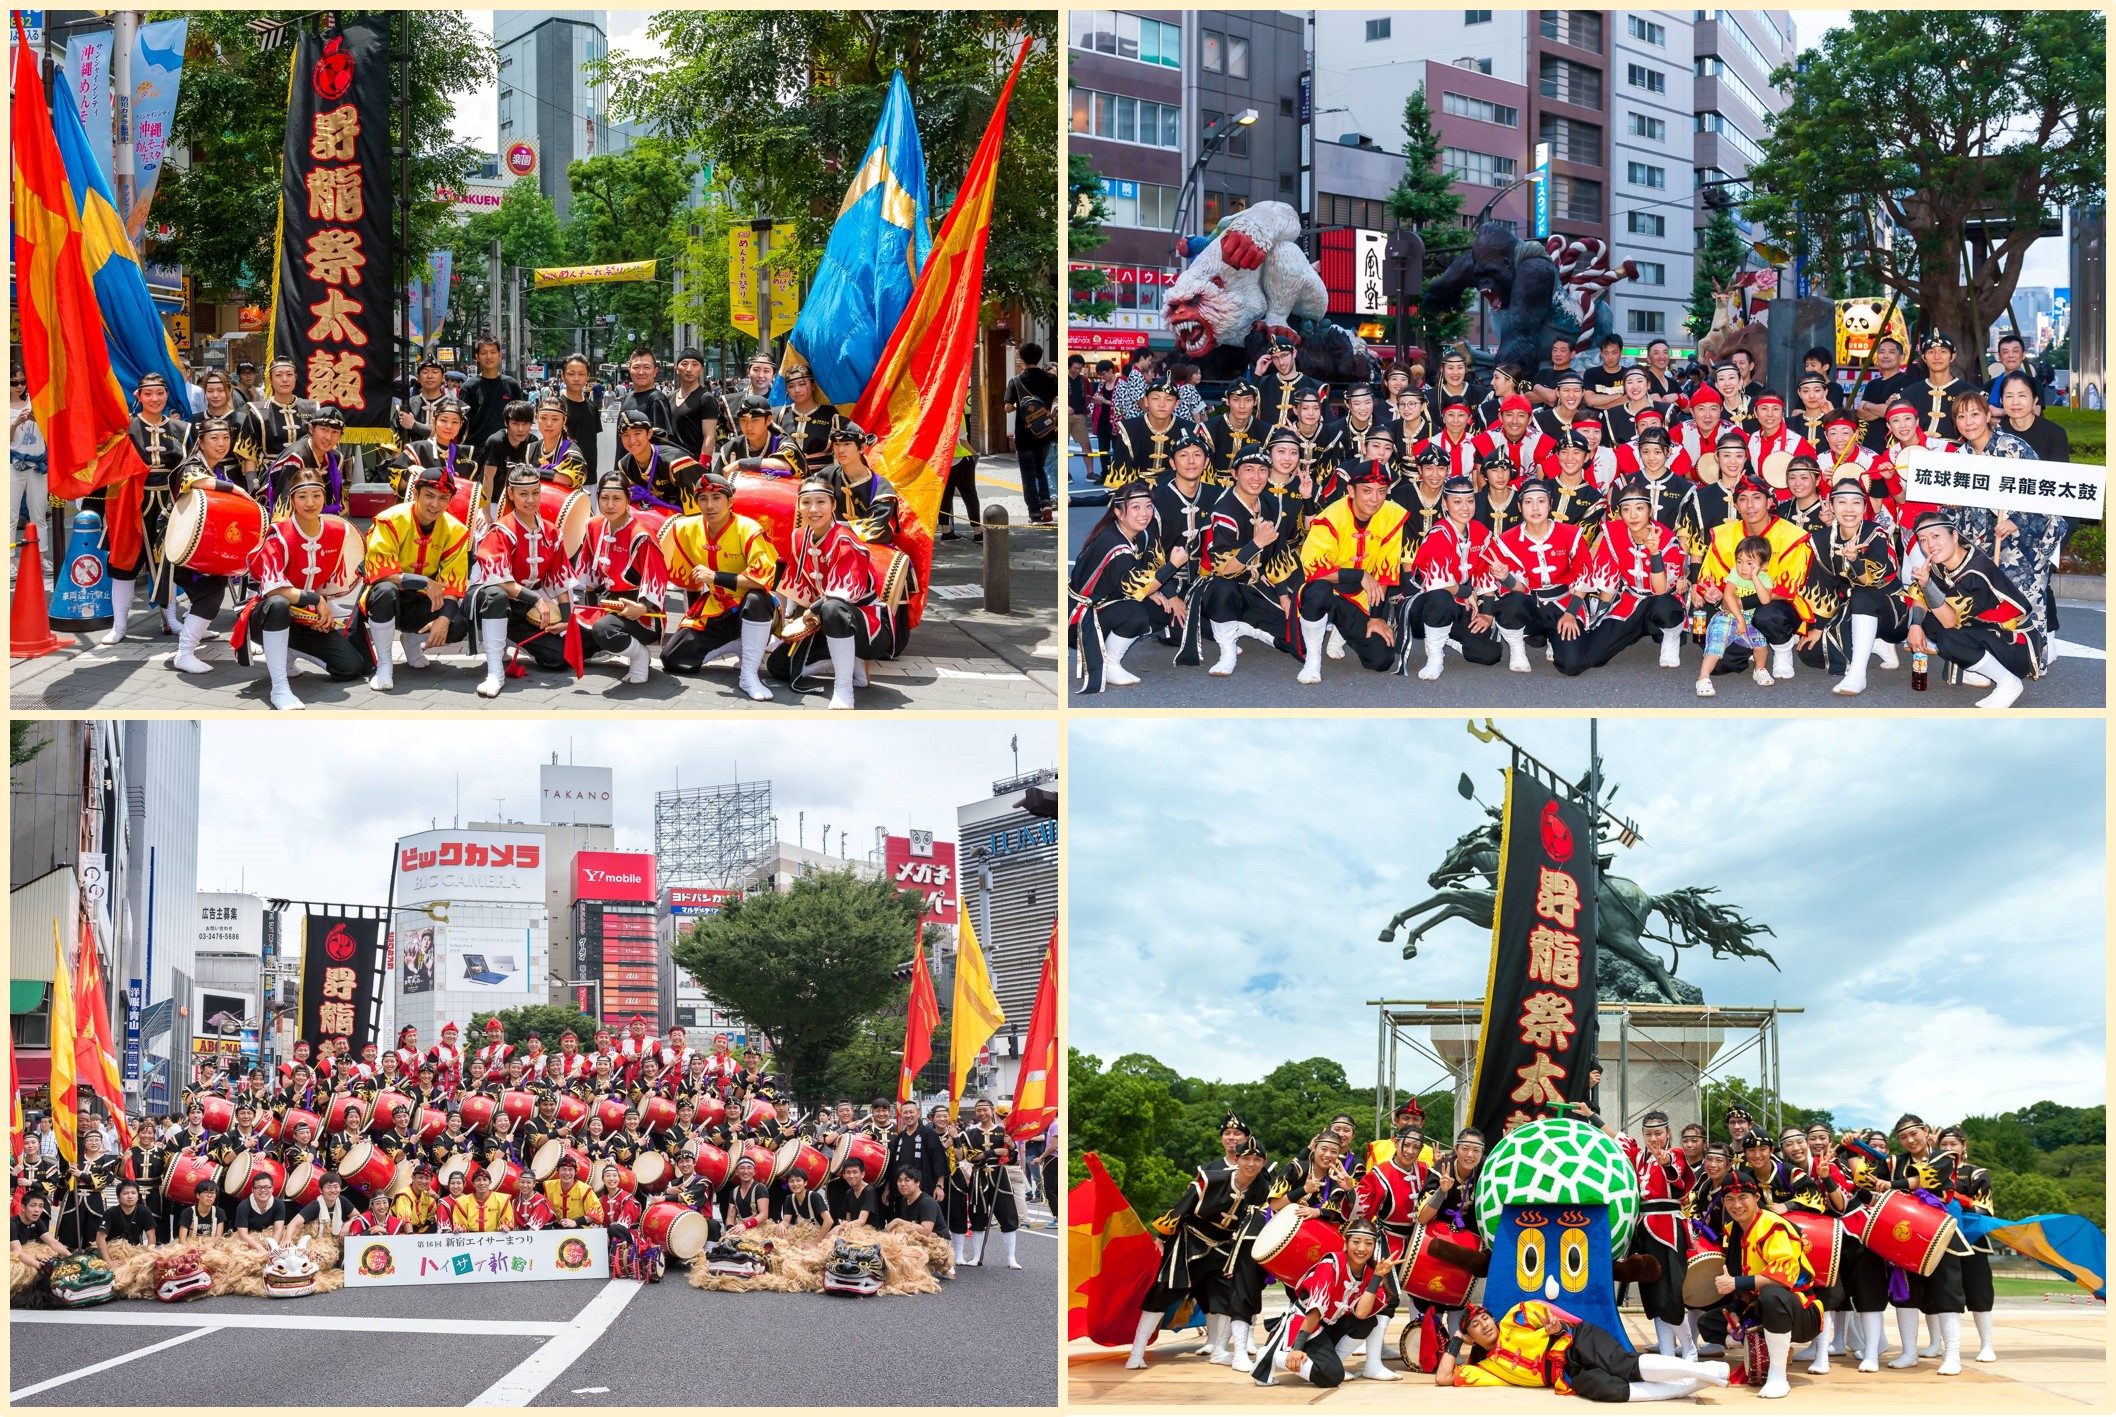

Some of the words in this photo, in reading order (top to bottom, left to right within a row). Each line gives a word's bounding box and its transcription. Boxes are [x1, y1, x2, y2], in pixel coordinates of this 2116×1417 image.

[139, 120, 162, 138] 沖縄
[511, 152, 532, 166] 楽園
[1914, 468, 1990, 491] 琉球舞団
[1998, 475, 2098, 501] 昇龍祭太鼓
[543, 789, 610, 800] TAKANO
[401, 842, 540, 872] ビックカメラ
[895, 861, 952, 886] メガネ
[413, 874, 439, 891] BIC
[441, 874, 522, 889] CAMERA
[201, 907, 238, 921] 広告主募集
[129, 987, 140, 1030] 洋服の青山
[625, 997, 641, 1005] au
[446, 1235, 534, 1247] 新宿エイサーまつり
